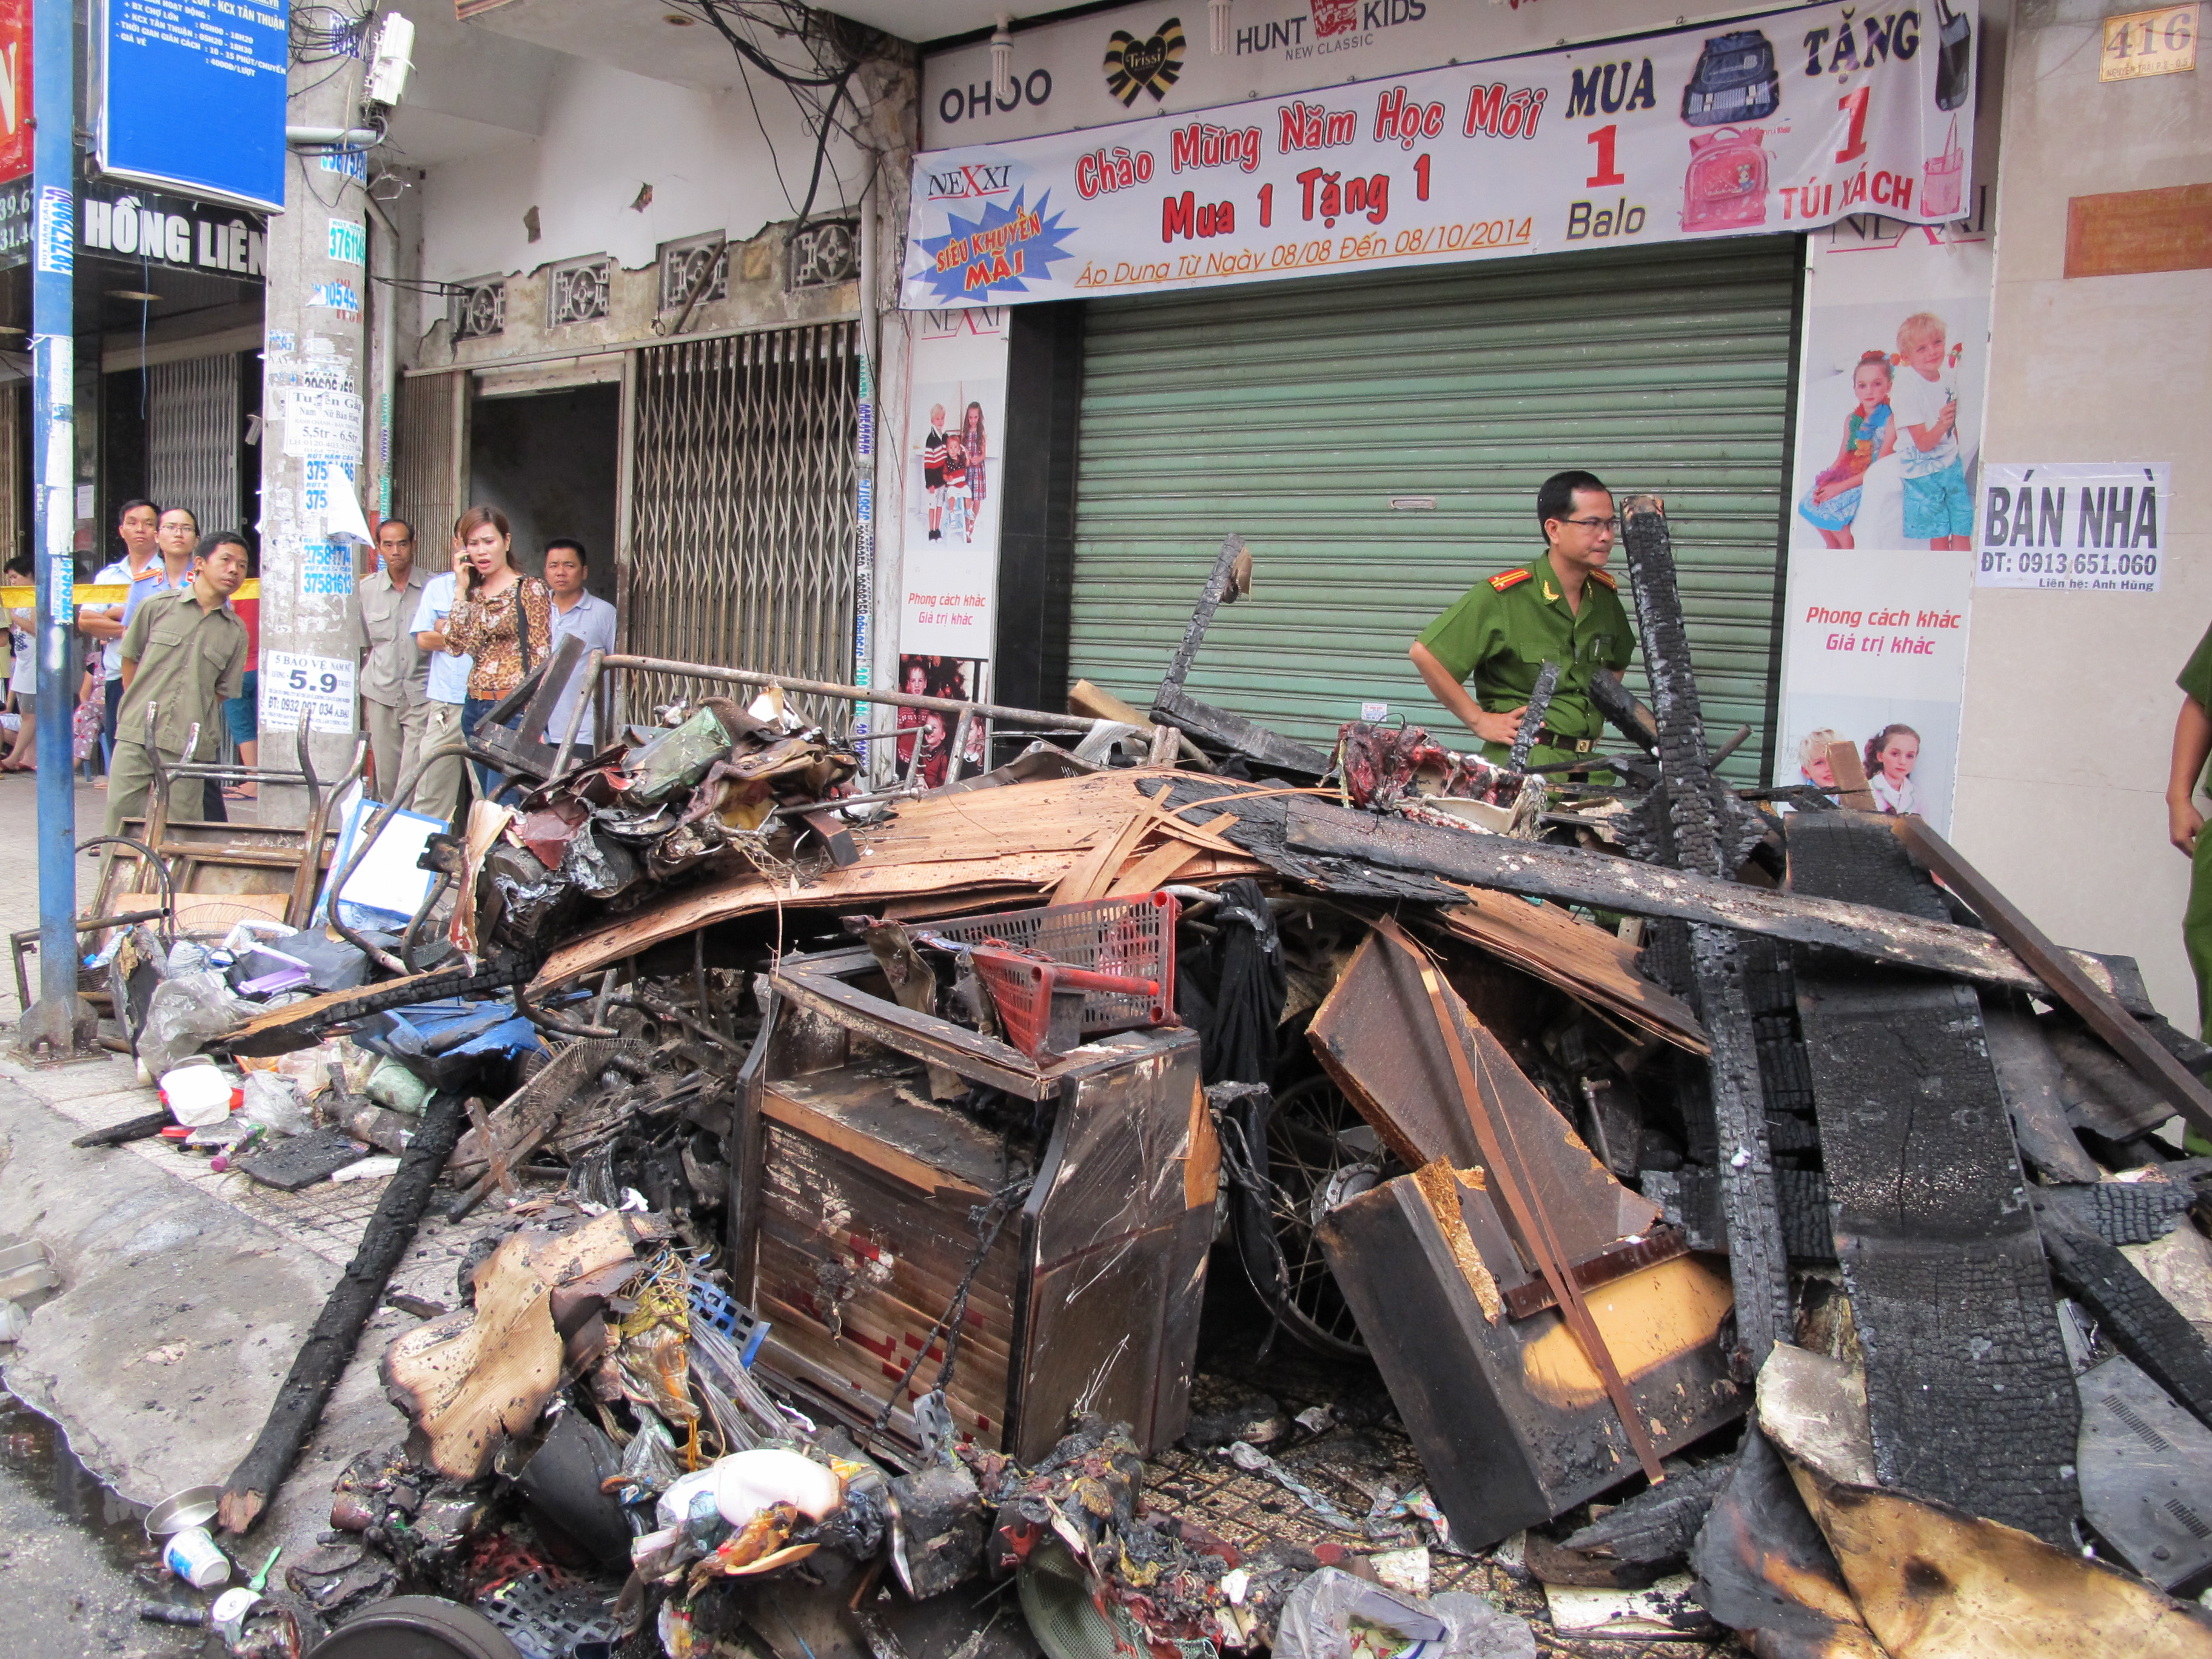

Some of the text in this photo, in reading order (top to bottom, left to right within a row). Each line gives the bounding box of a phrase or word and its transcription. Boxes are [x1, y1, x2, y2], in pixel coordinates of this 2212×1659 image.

[132, 2, 144, 12] BX
[144, 6, 162, 18] CHỢ
[199, 22, 224, 35] 05H00
[230, 31, 254, 44] 18H20
[162, 0, 183, 12] HOẠT
[184, 6, 206, 19] ĐỘNG
[218, 0, 235, 16] KCX
[237, 5, 255, 21] TÂN
[256, 12, 285, 31] THUẬN
[1236, 0, 1427, 56] HUNT KIDS
[121, 33, 135, 43] GIÁ
[121, 21, 140, 33] THỜI
[141, 27, 159, 39] GIAN
[180, 38, 201, 50] CÁCH
[209, 46, 220, 56] 10
[226, 52, 235, 60] 15
[132, 13, 253, 55] KCX TÂN THUẬN 05H20 18H30
[1285, 33, 1373, 61] NEW CLASSIC
[2106, 13, 2191, 59] 416
[1125, 47, 1162, 69] Trissi
[1566, 8, 1921, 119] MUA TẶNG
[1074, 82, 1547, 201] Chào Mừng Năm Học Mới
[1586, 86, 1871, 189] 1 1
[928, 164, 1012, 198] NEXXI
[1162, 153, 1430, 243] Mua 1 Tặng 1
[1779, 161, 1913, 220] TÚI XÁCH
[85, 195, 190, 263] HỒNG
[197, 219, 267, 276] LIÊN
[1566, 197, 1646, 240] Balo
[937, 205, 1042, 273] SIÊU KHUYẾN
[1075, 261, 1108, 285] Áp
[1178, 254, 1202, 276] Từ
[1206, 248, 1266, 277] Ngày
[1272, 241, 1332, 267] 08/08
[1339, 232, 1387, 260] Đến
[1395, 216, 1532, 254] 08/10/2014
[964, 247, 1024, 291] MÃI
[1985, 468, 2157, 549] BÁN NHÀ
[1981, 551, 2012, 573] ĐT:
[908, 592, 986, 607] Phong cách khác
[2039, 578, 2065, 588] Liên
[2069, 578, 2088, 590] hệ:
[2092, 579, 2116, 589] Anh
[919, 611, 973, 627] Giá trị khác
[1805, 606, 1962, 629] Phong cách khác
[275, 655, 281, 663] 5
[283, 655, 308, 667] BẢO
[311, 659, 327, 671] VỆ
[1826, 632, 1936, 656] Giá trị khác
[289, 669, 338, 693] 5.9
[281, 698, 300, 712] 0932
[319, 703, 333, 716] 034
